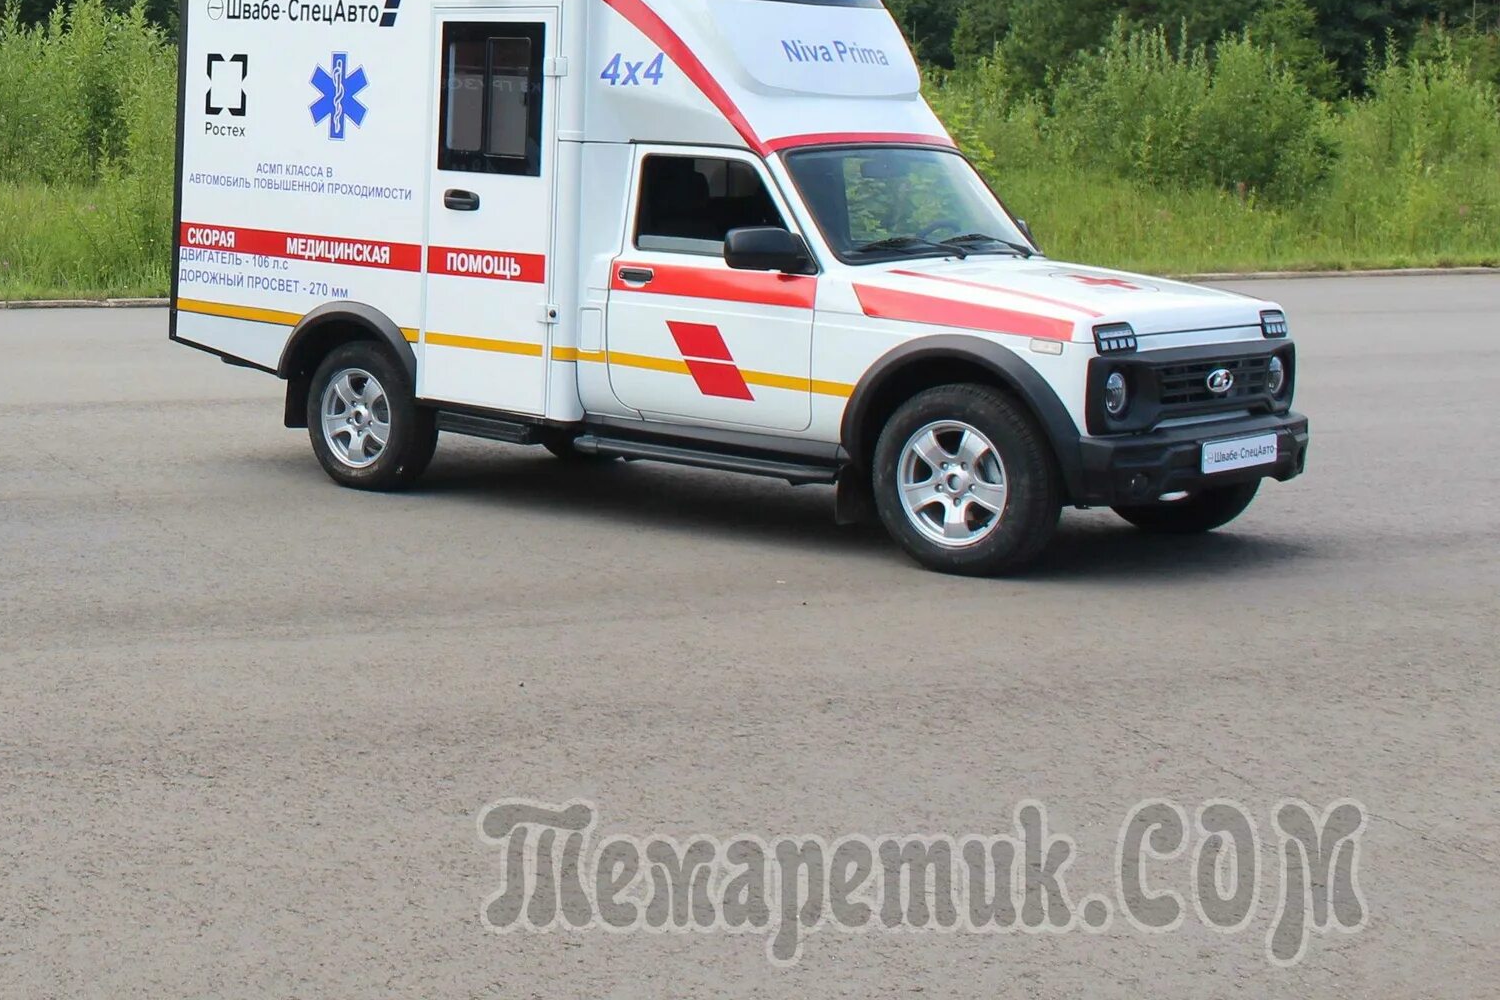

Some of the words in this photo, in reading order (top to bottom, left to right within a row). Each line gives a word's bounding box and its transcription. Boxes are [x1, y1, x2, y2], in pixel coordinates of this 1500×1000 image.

[781, 39, 830, 63] Niva
[833, 41, 890, 66] Prima
[600, 52, 665, 86] 4x4
[204, 121, 245, 137] Ростех
[256, 163, 283, 176] АСМП
[285, 164, 323, 177] КЛАССА
[188, 173, 251, 189] АВТОМОБИЛЬ
[253, 178, 325, 194] ПОВЫШЕННОЙ
[327, 183, 412, 200] ПРОХОДИМОСТИ
[180, 248, 242, 266] ДВИГАТЕЛЬ
[252, 255, 269, 269] 106
[187, 227, 235, 248] СКОРАЯ
[286, 237, 390, 264] МЕДИЦИНСКАЯ
[446, 252, 521, 279] ПОМОЩЬ
[179, 269, 244, 288] ДОРОЖНЫЙ
[247, 275, 300, 293] ПРОСВЕТ
[309, 282, 328, 297] 270
